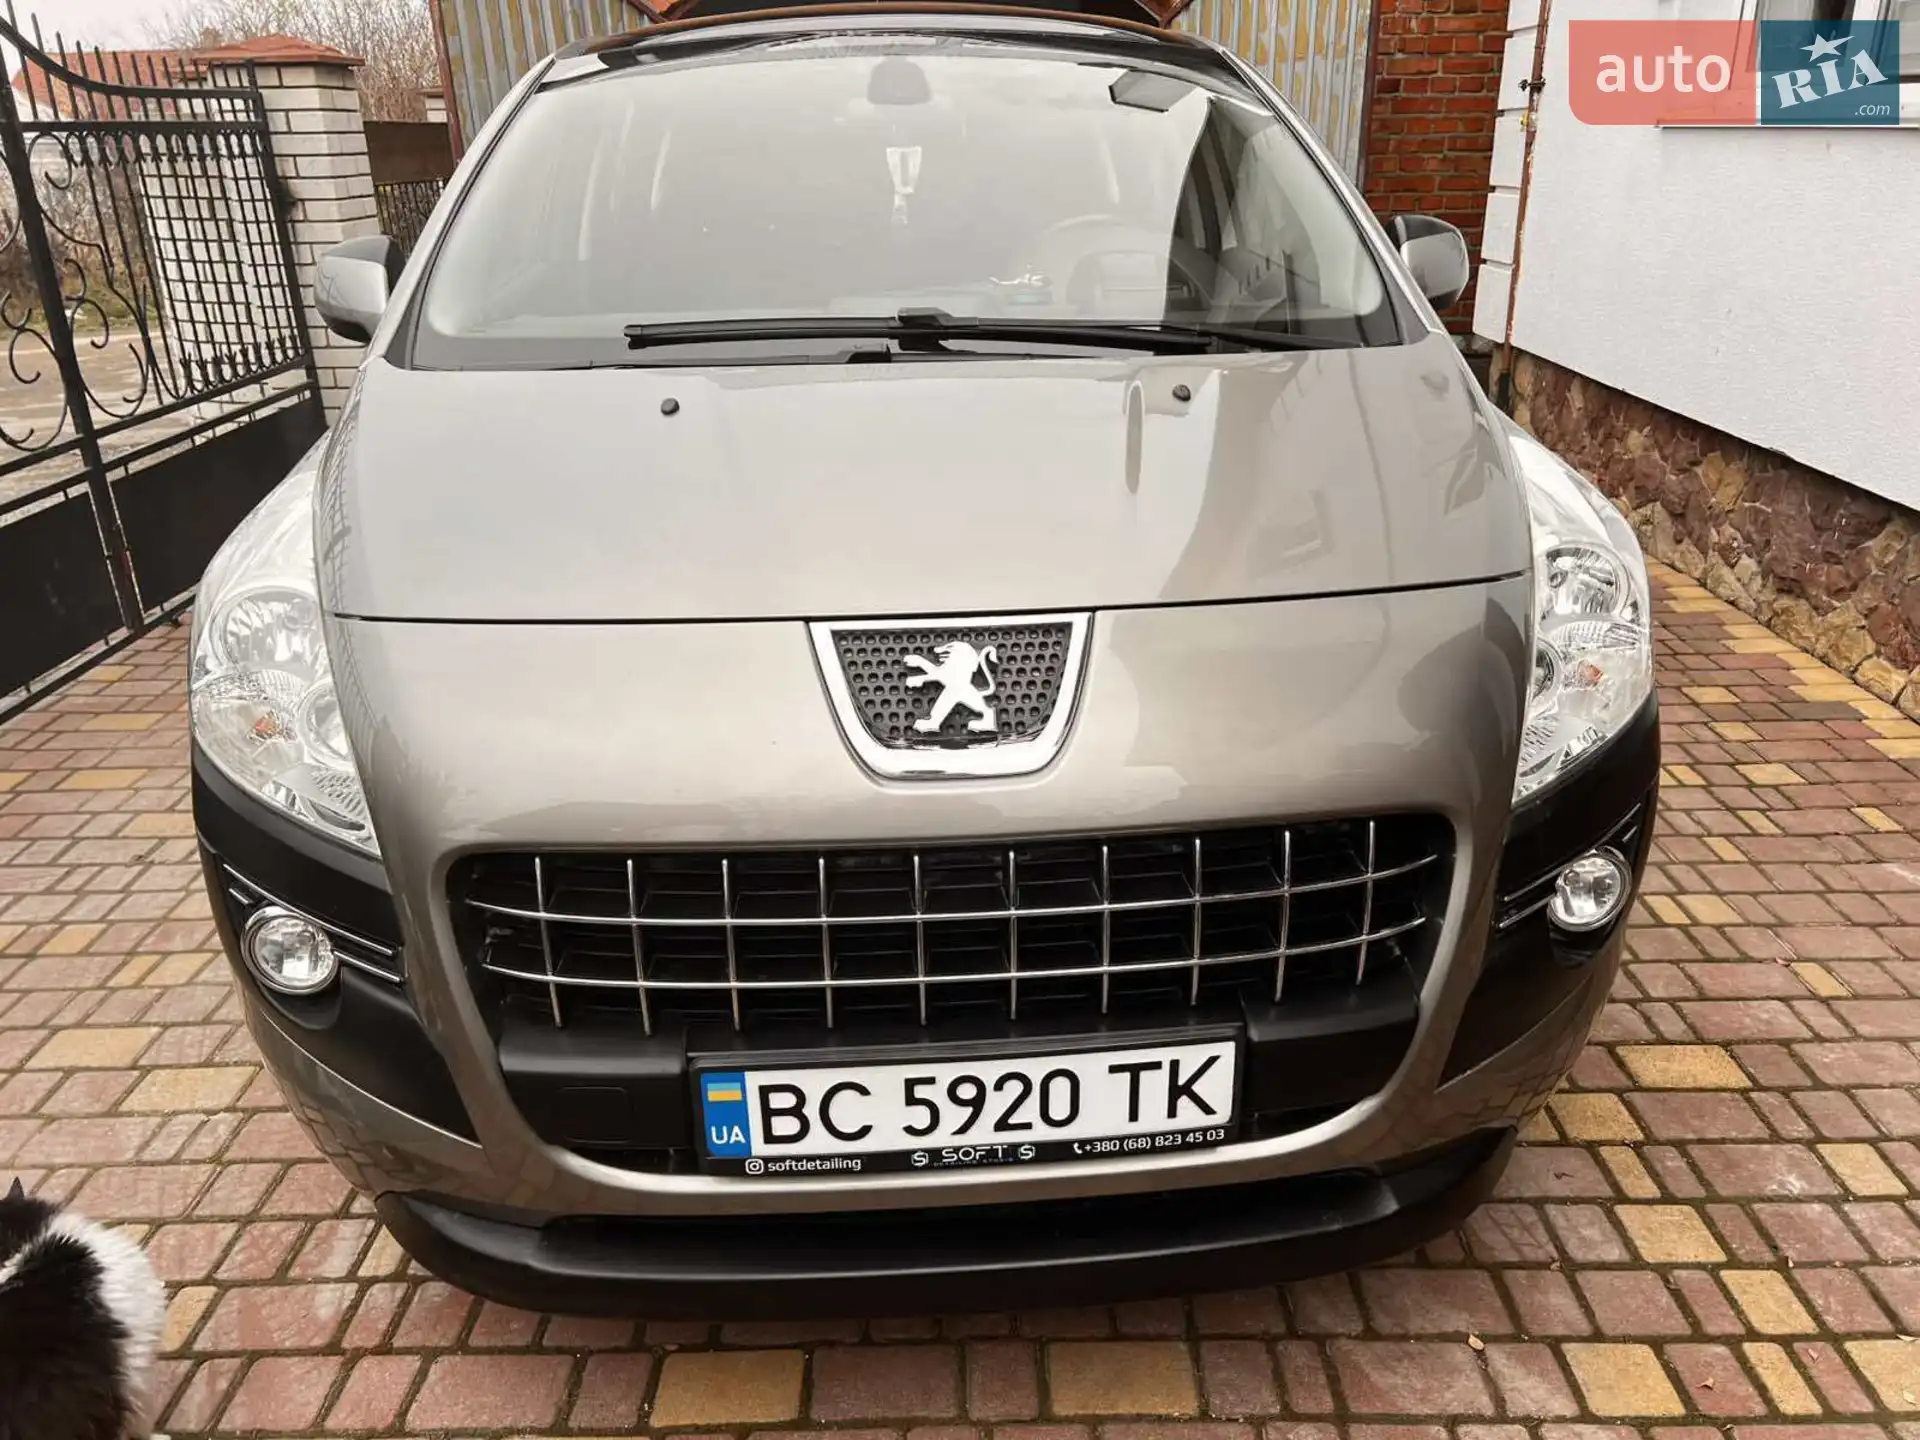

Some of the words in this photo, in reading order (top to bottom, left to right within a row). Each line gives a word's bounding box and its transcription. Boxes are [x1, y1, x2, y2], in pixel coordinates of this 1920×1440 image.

[758, 1081, 873, 1144] BC
[902, 1067, 1080, 1137] 5920
[1108, 1055, 1221, 1123] TK
[711, 1125, 746, 1144] UA
[1084, 1140, 1120, 1153] +380
[1123, 1136, 1151, 1151] (68)
[1155, 1133, 1182, 1147] 823
[1185, 1131, 1203, 1144] 45
[1206, 1128, 1225, 1141] 03
[941, 1145, 1008, 1162] SOFT
[767, 1157, 862, 1173] softdetailing
